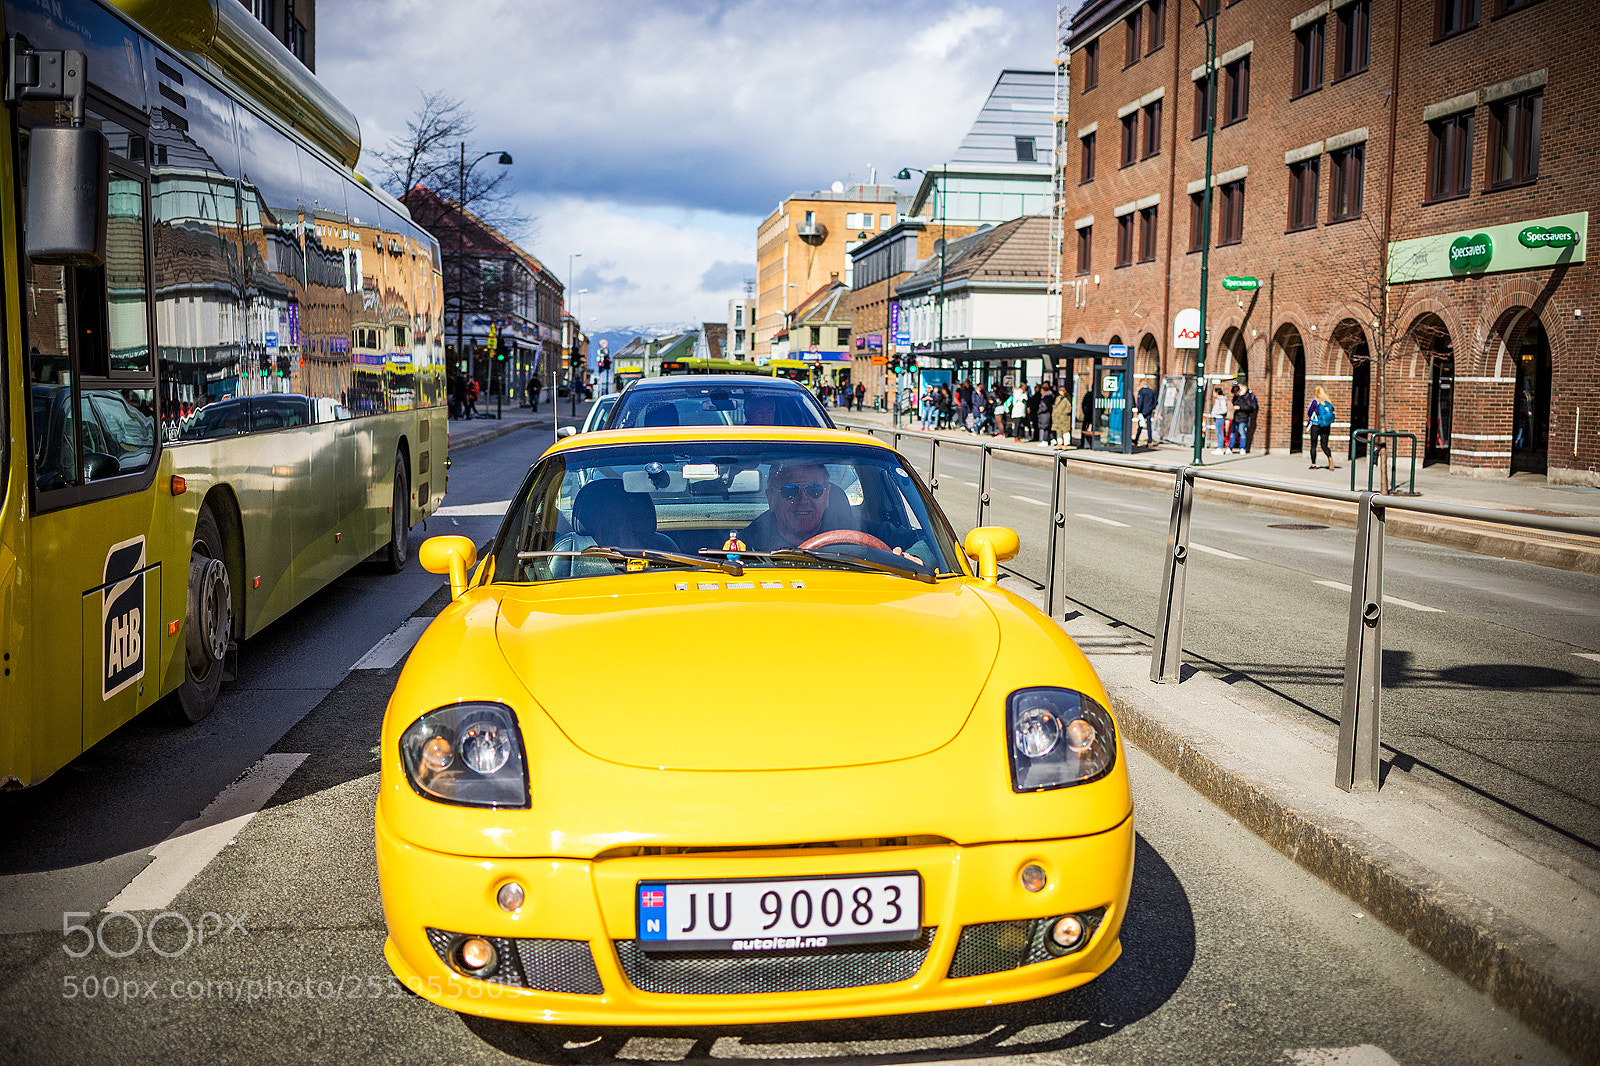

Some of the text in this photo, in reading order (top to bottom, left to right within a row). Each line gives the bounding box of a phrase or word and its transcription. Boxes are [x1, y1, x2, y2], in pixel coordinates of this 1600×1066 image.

[1526, 231, 1572, 243] Specsavers
[1451, 243, 1486, 259] Specsavers
[108, 607, 141, 679] AtB
[682, 885, 903, 933] JU 90083
[646, 919, 660, 933] N
[731, 936, 828, 951] autoital.no
